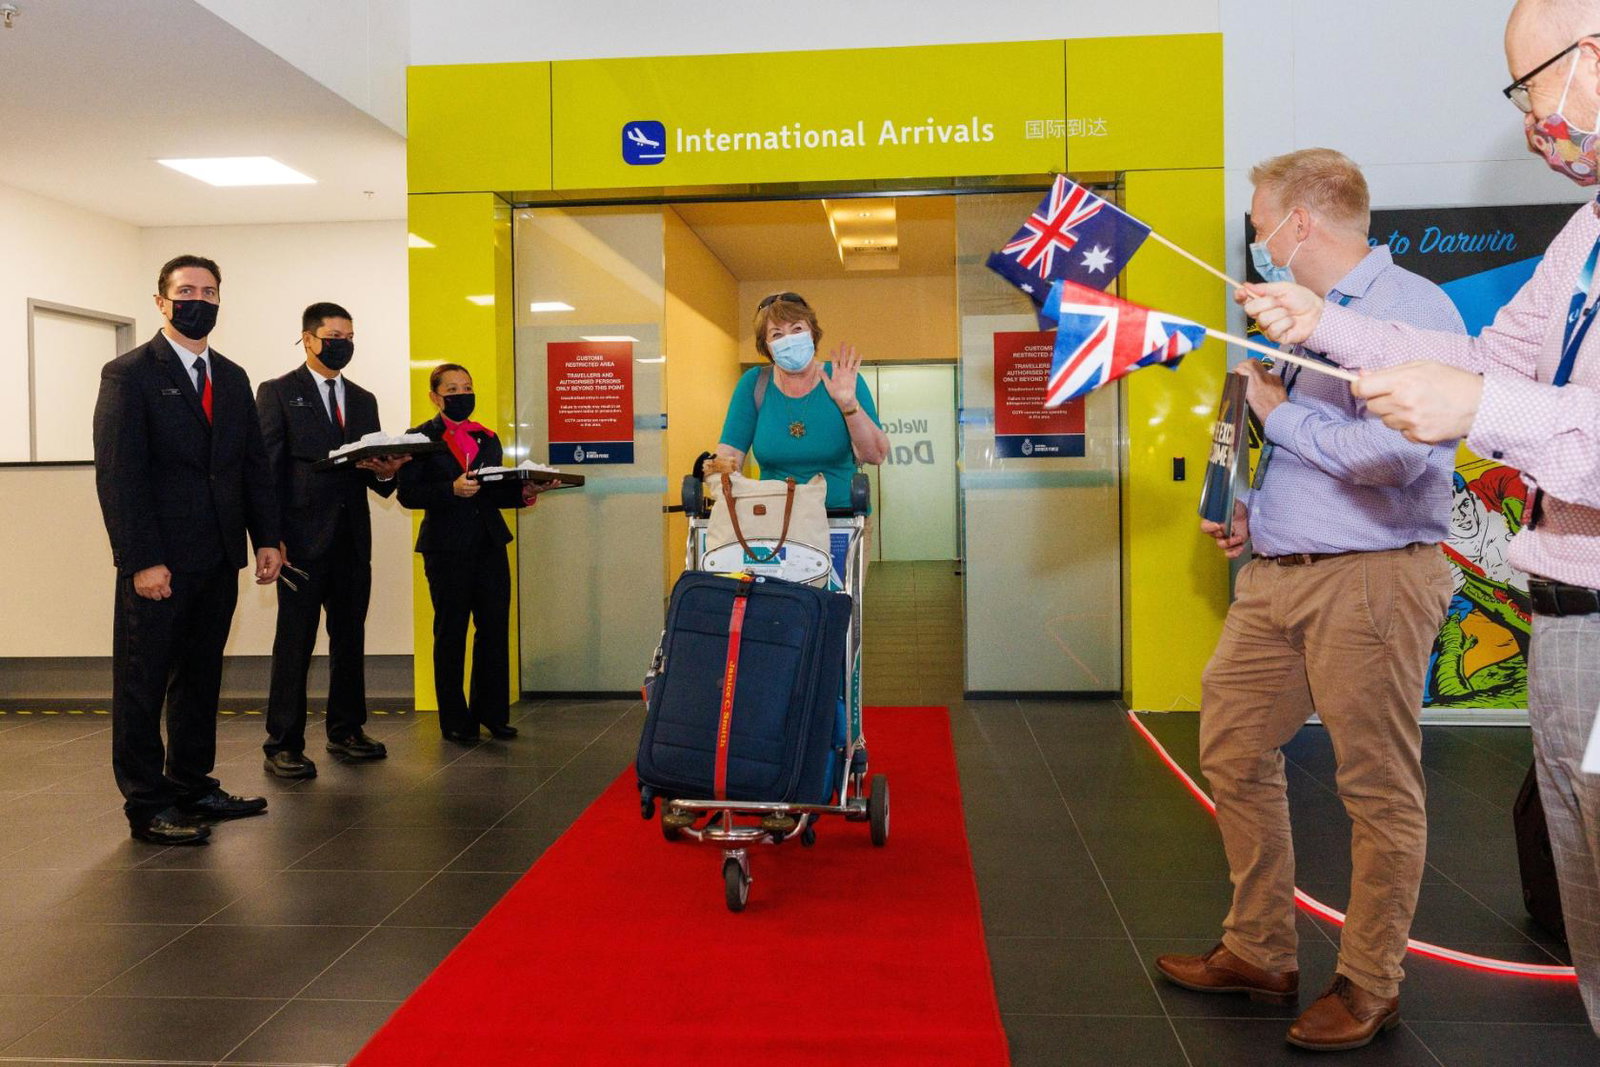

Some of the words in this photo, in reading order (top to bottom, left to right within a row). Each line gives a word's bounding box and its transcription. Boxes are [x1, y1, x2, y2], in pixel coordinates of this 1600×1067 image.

[676, 121, 866, 153] International
[878, 116, 994, 145] Arrivals
[1024, 118, 1108, 140] 国际到达
[1388, 230, 1411, 255] to
[1419, 226, 1518, 254] Darwin
[725, 660, 735, 698] Janice
[720, 712, 730, 747] Smith
